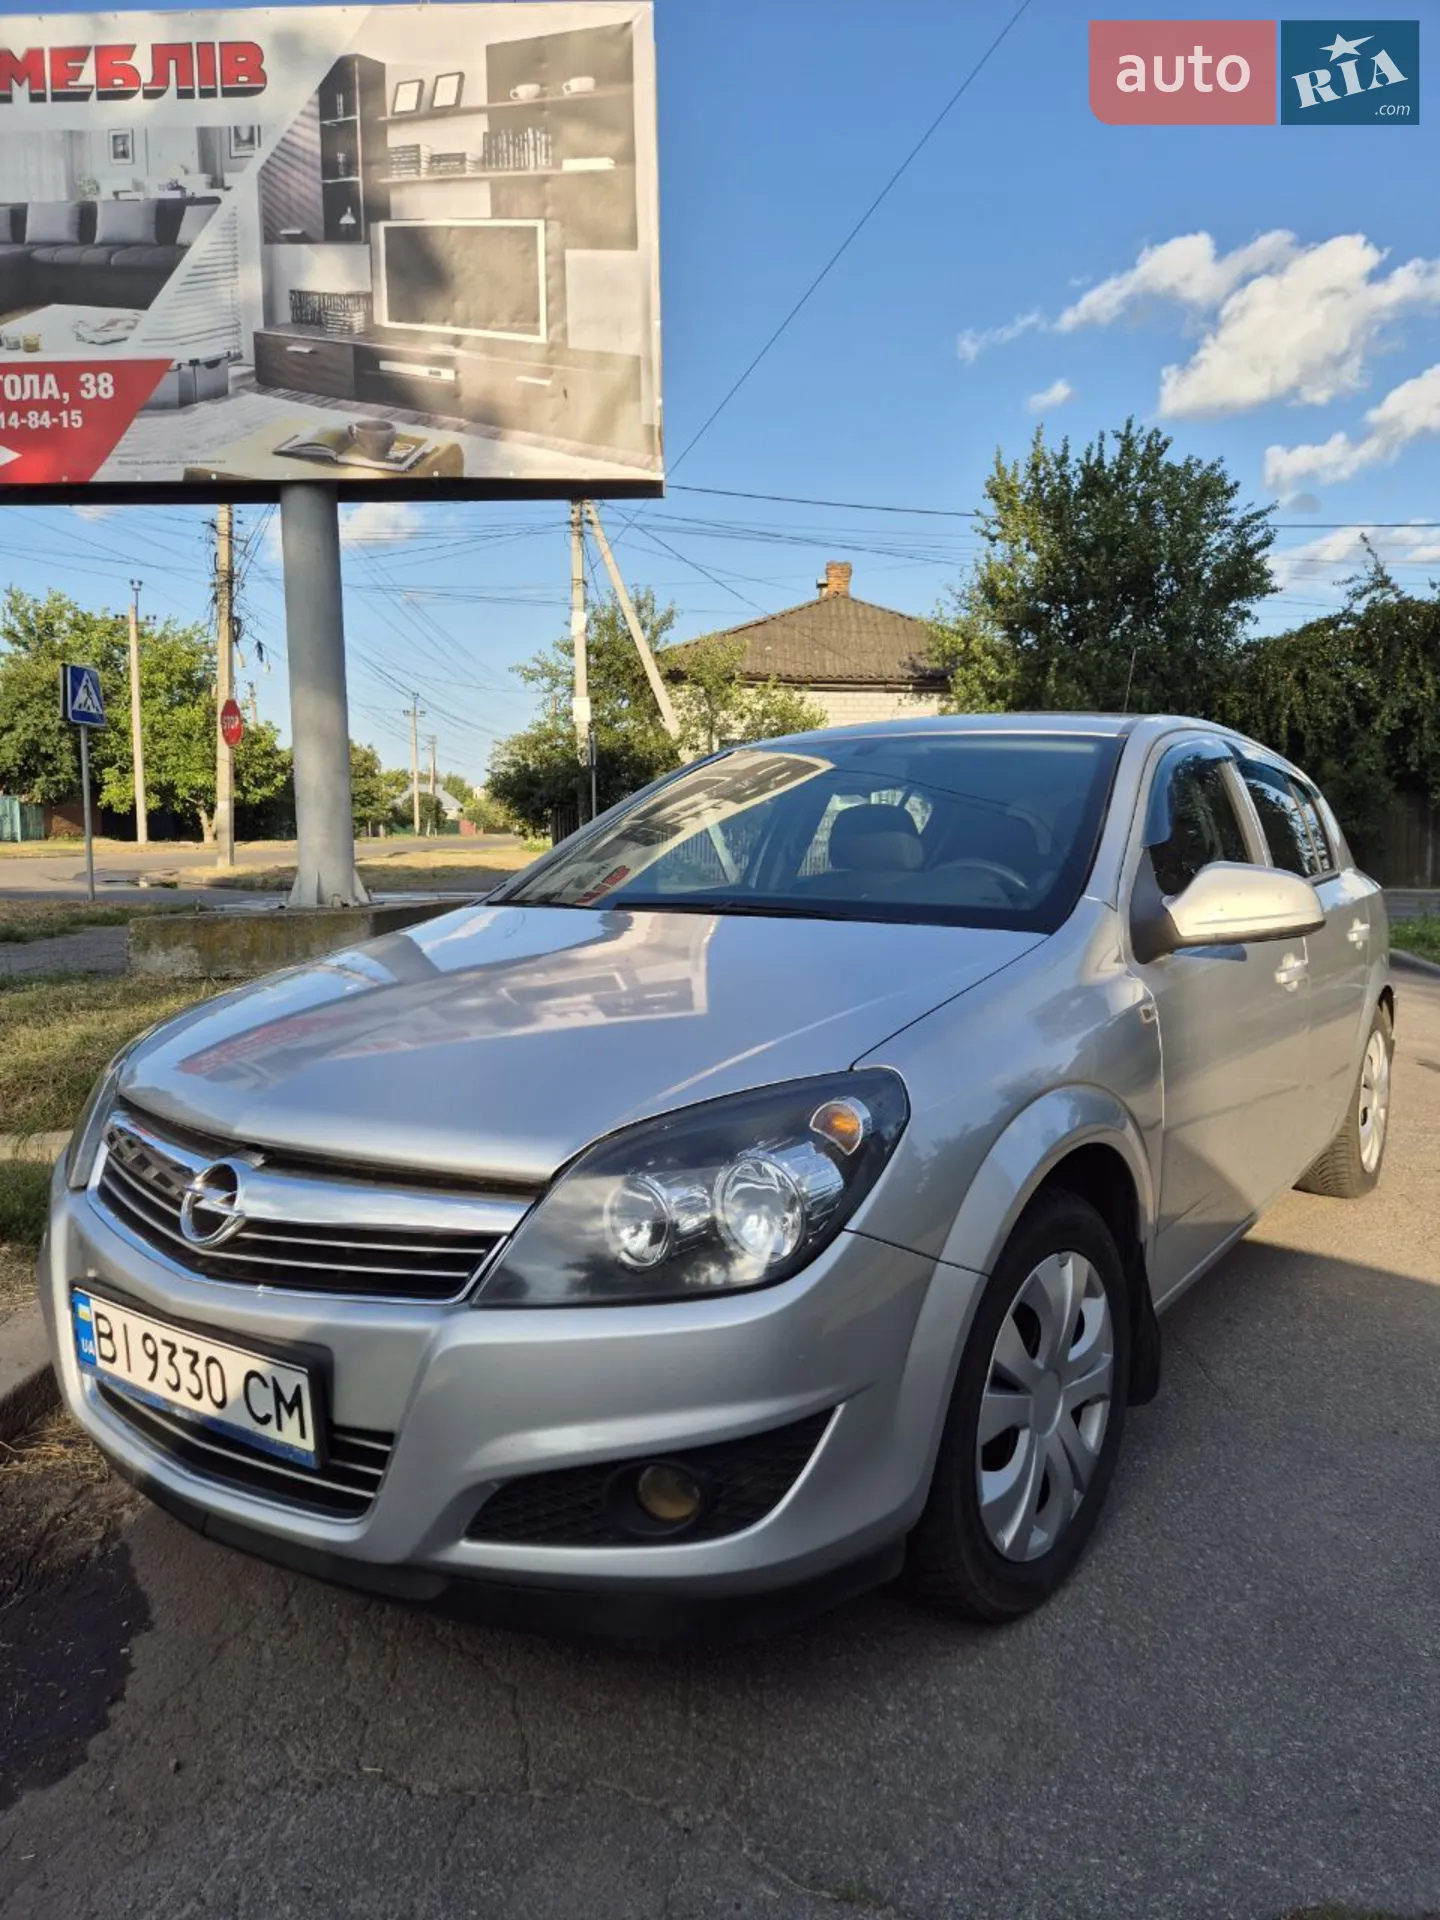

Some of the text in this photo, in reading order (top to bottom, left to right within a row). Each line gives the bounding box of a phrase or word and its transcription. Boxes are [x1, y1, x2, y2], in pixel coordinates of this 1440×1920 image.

[0, 41, 267, 103] МЕБЛІВ
[0, 372, 114, 404] ОЛА, 38
[222, 715, 240, 730] STOP
[81, 1338, 95, 1355] UA
[94, 1311, 306, 1439] BI 9330 CM
